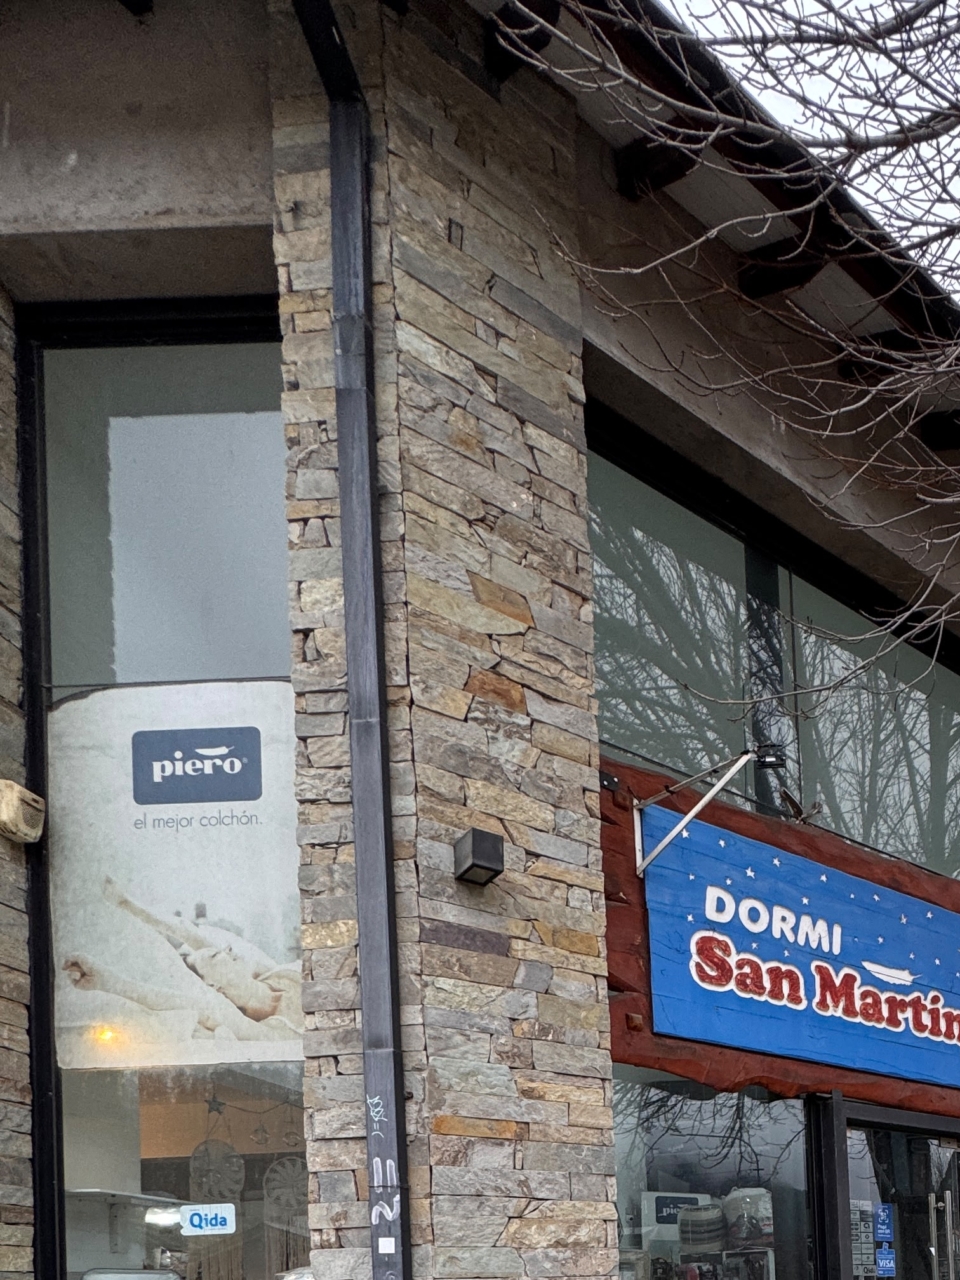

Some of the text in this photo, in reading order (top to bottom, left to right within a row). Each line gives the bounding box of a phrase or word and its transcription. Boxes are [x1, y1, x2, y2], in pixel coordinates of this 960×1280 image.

[152, 750, 243, 782] piero
[133, 812, 147, 829] el
[152, 814, 194, 833] mejor
[705, 884, 842, 956] DORMI
[690, 929, 808, 1010] San
[189, 1212, 228, 1230] Qida
[878, 1260, 895, 1268] VISA
